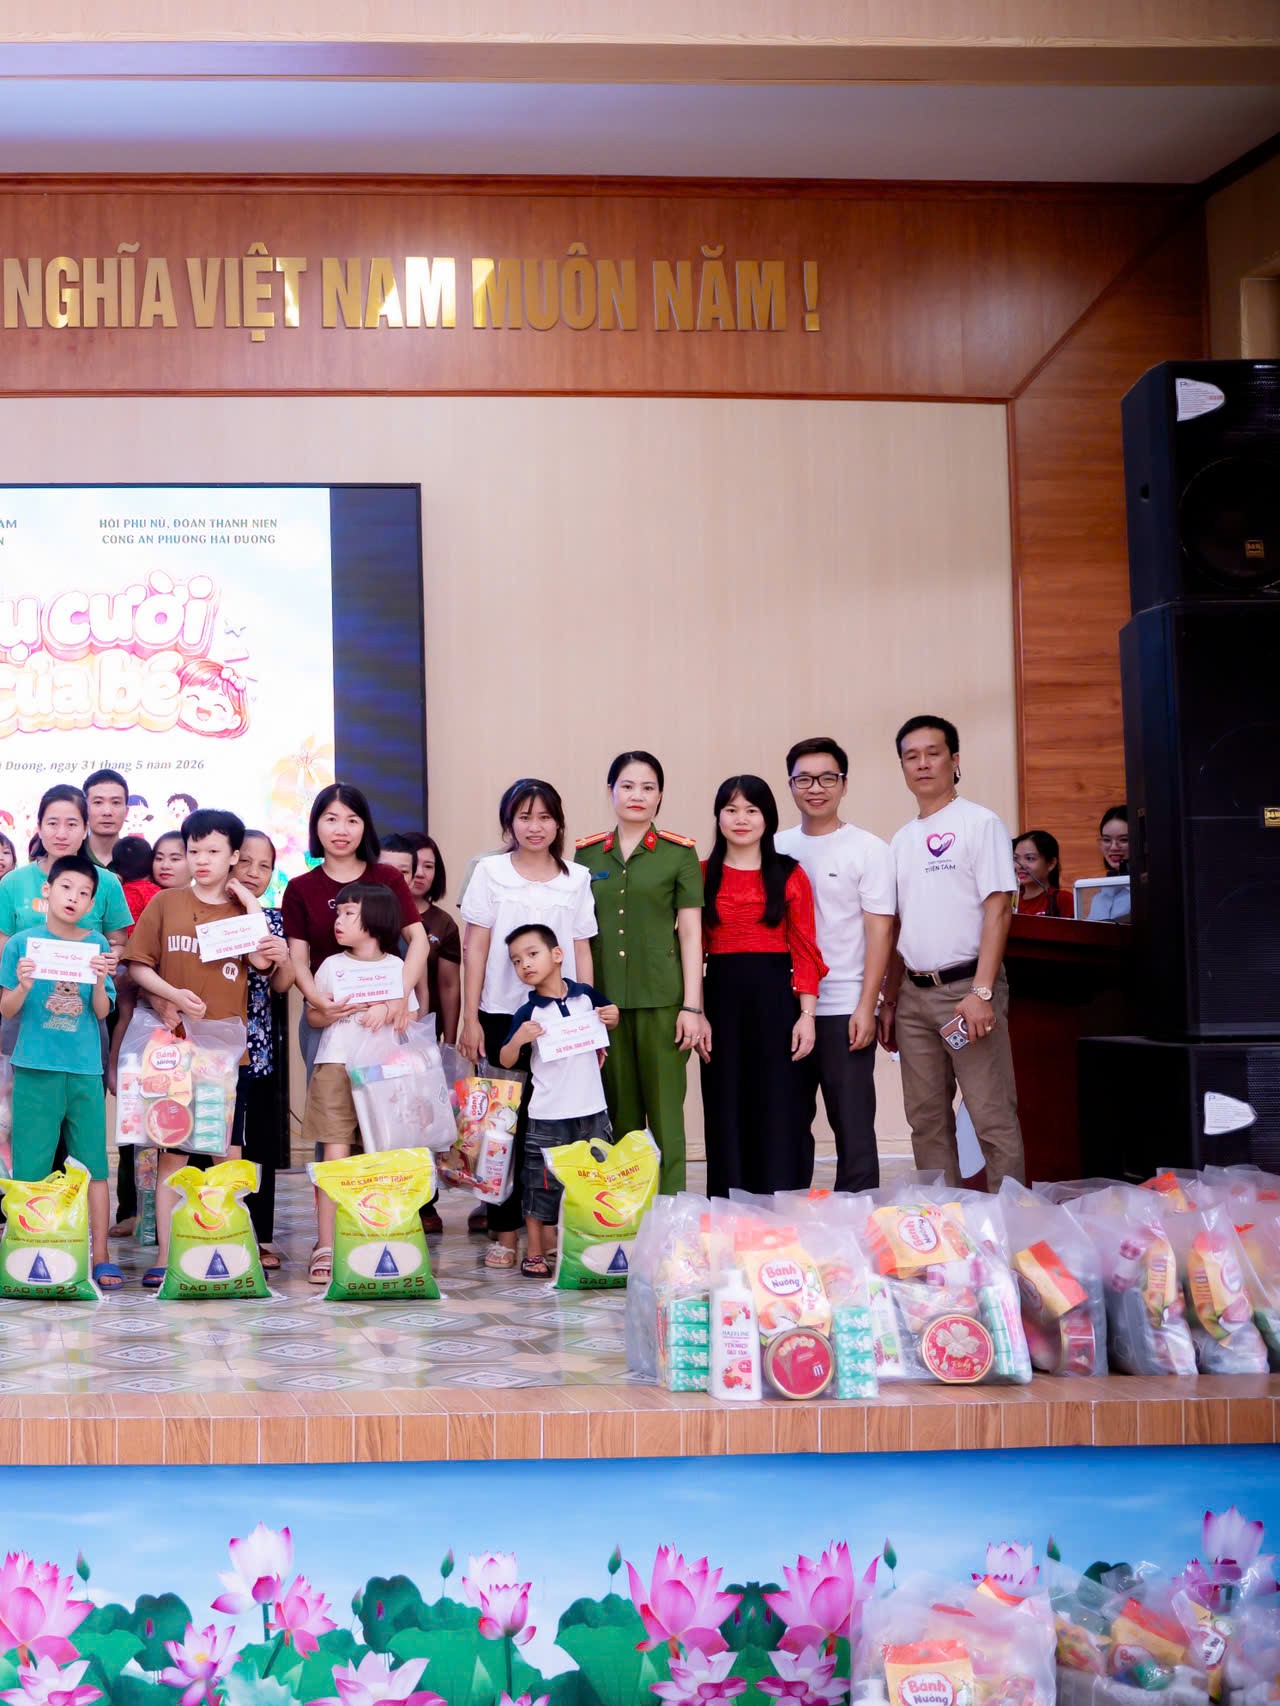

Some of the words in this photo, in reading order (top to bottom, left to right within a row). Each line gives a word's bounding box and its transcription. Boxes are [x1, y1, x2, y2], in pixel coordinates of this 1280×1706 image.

[5, 242, 179, 329] NGHĨA
[184, 241, 308, 342] VIỆT
[323, 256, 455, 329] NAM
[472, 242, 638, 331] MUÔN
[654, 244, 786, 331] NĂM
[138, 534, 154, 544] AN
[81, 760, 96, 770] 31
[136, 760, 144, 770] 5
[175, 759, 205, 770] 2026
[224, 965, 236, 976] OK
[213, 1283, 230, 1291] ST
[234, 1277, 255, 1290] 25
[382, 1281, 399, 1290] ST
[403, 1276, 425, 1289] 25
[35, 1287, 52, 1295] ST
[907, 1679, 947, 1693] Bánh
